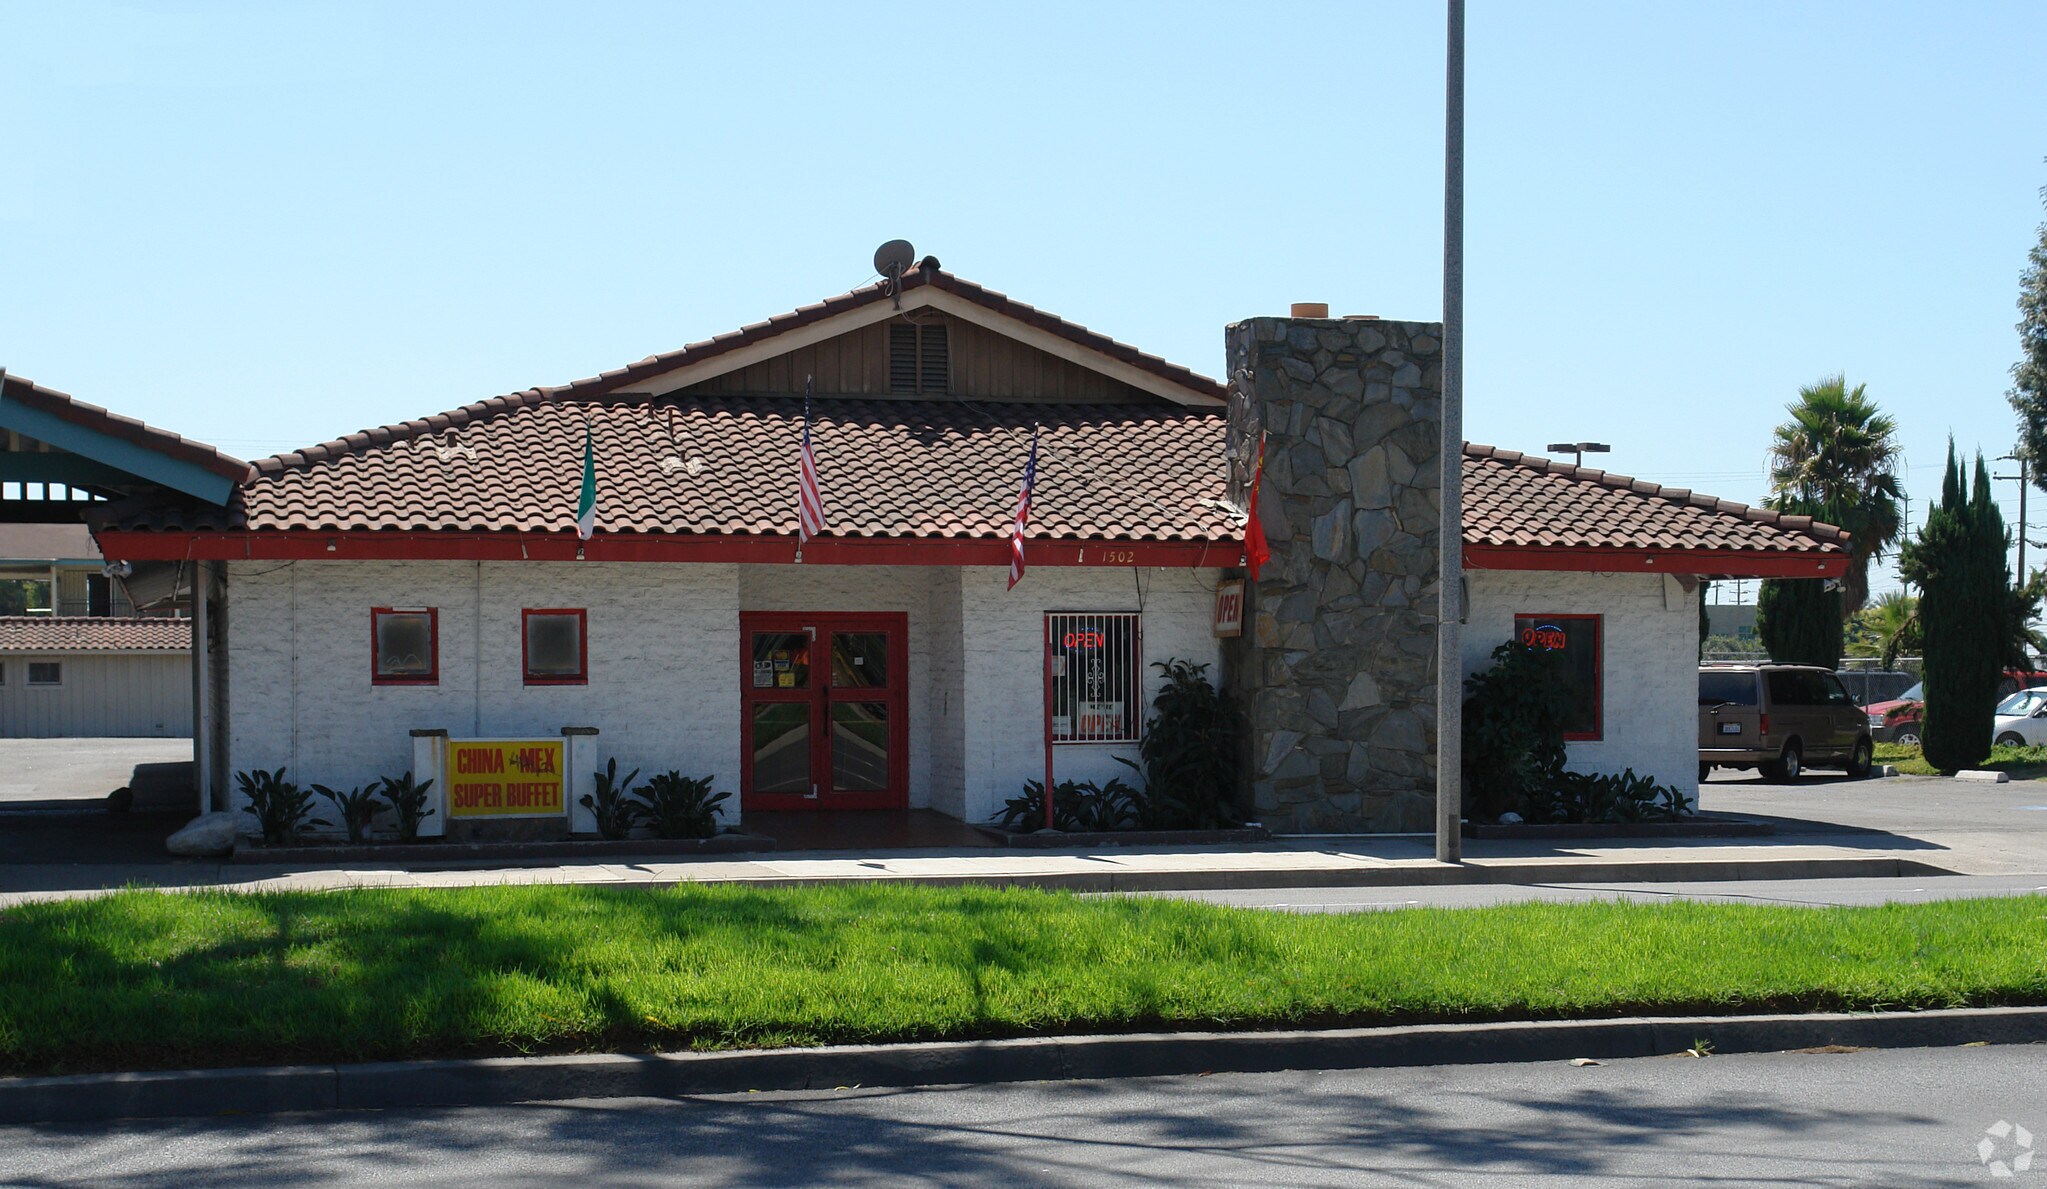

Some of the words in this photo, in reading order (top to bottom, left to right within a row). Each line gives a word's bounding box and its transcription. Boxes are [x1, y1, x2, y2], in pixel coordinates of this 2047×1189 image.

[1102, 551, 1134, 563] 1502
[1217, 593, 1239, 625] OPEN
[1064, 632, 1105, 648] OPEN
[1521, 627, 1566, 649] OPEN
[1081, 714, 1121, 733] OPEN
[457, 748, 505, 774] CHINA
[519, 747, 555, 774] MEX
[454, 783, 502, 808] SUPER
[506, 782, 559, 807] BUFFET
